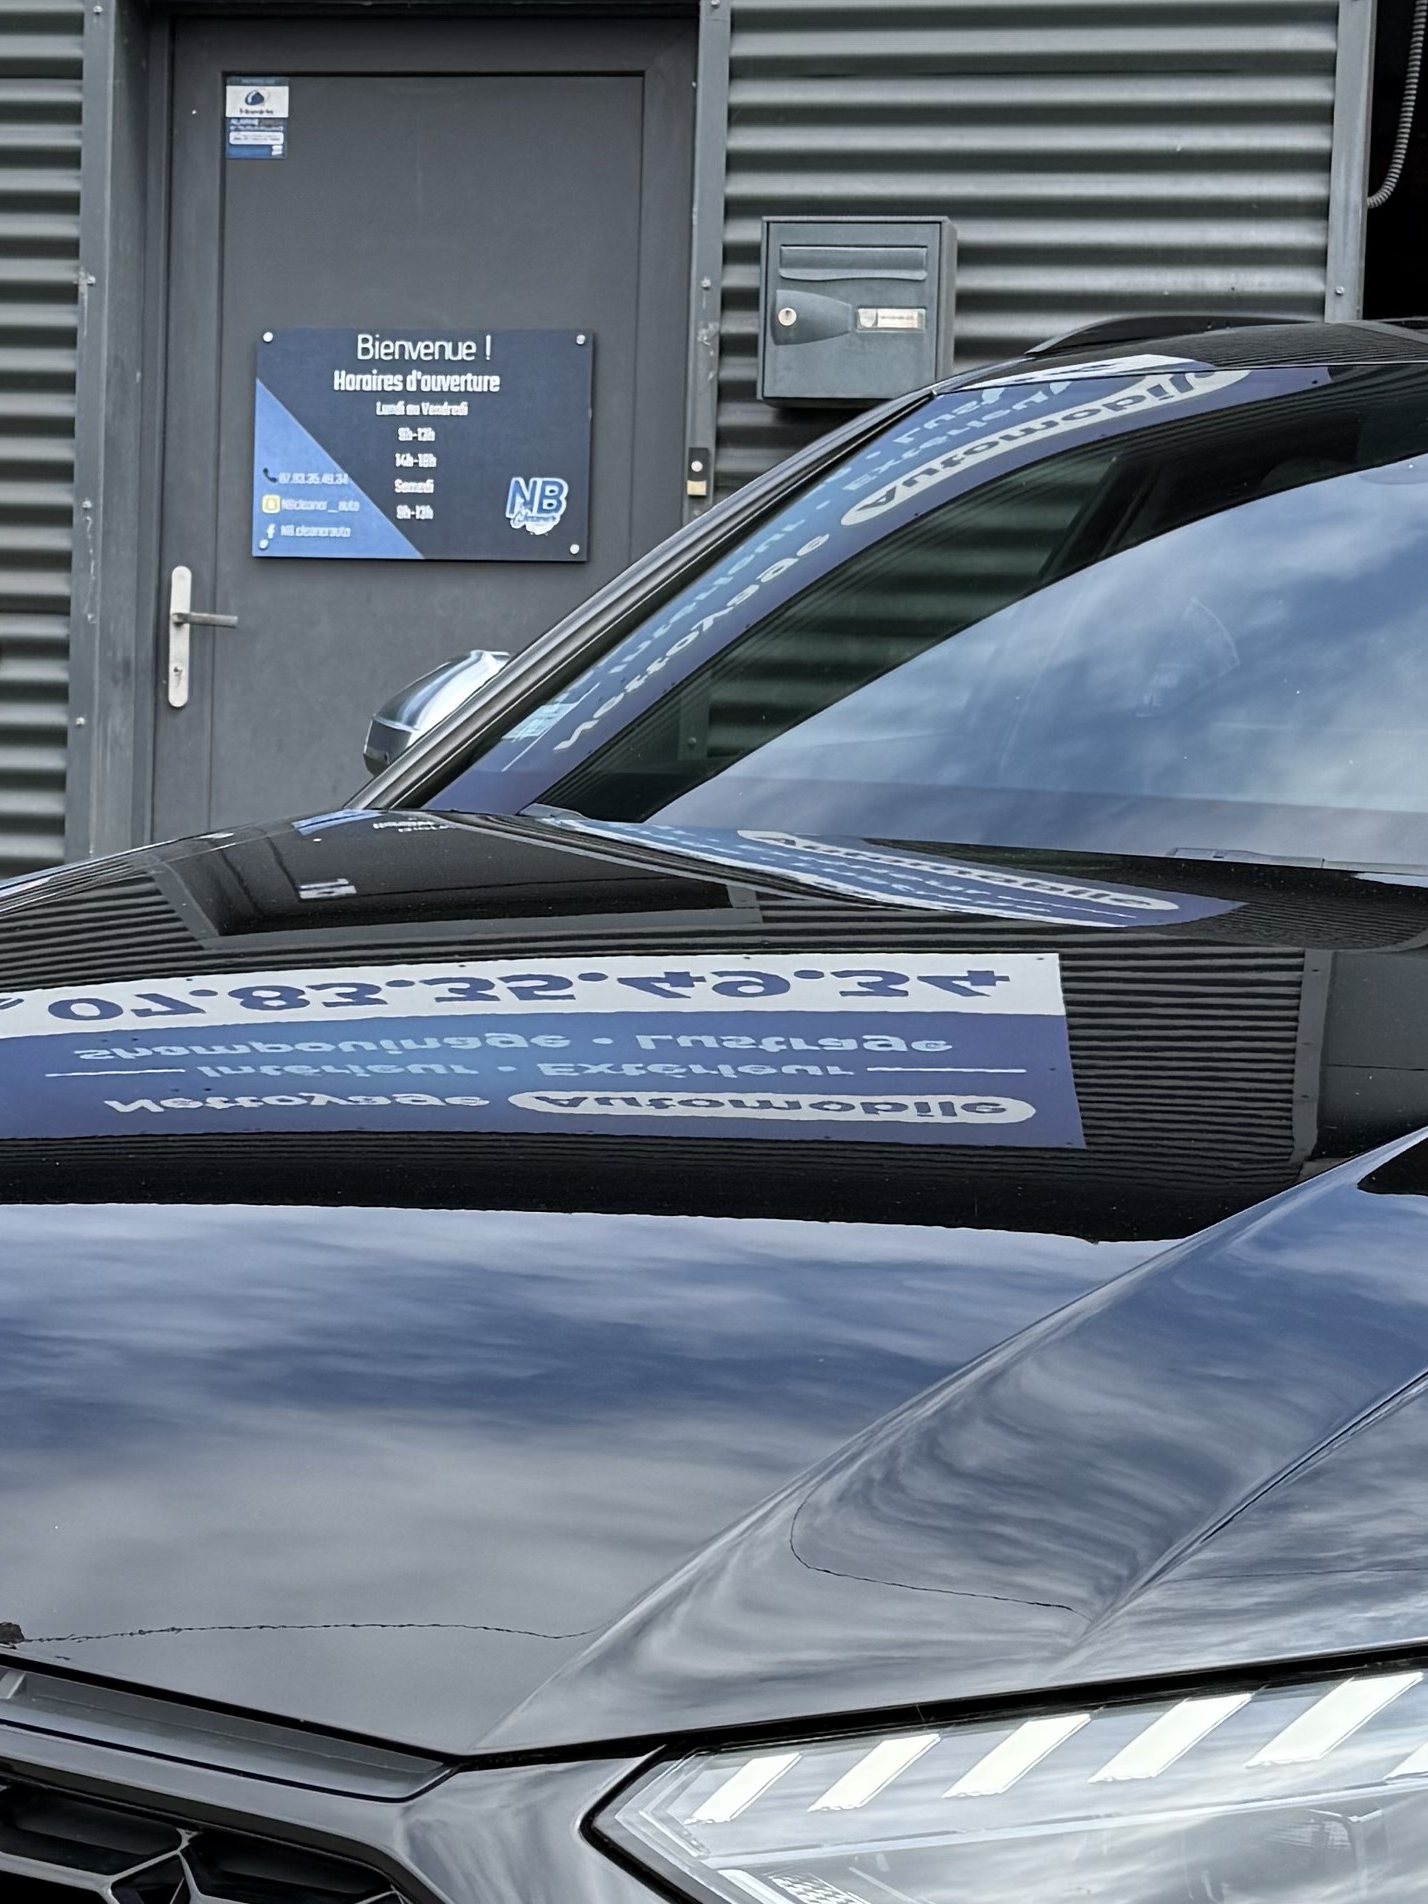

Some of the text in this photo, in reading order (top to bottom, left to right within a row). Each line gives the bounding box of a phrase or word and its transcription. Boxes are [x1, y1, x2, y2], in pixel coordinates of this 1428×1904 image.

[356, 333, 477, 362] Bienvenue
[333, 369, 501, 393] Horaires d'ouverture
[375, 400, 406, 416] Lundi
[421, 401, 469, 417] Vendredi
[394, 478, 435, 494] Samedi
[505, 476, 570, 519] NB
